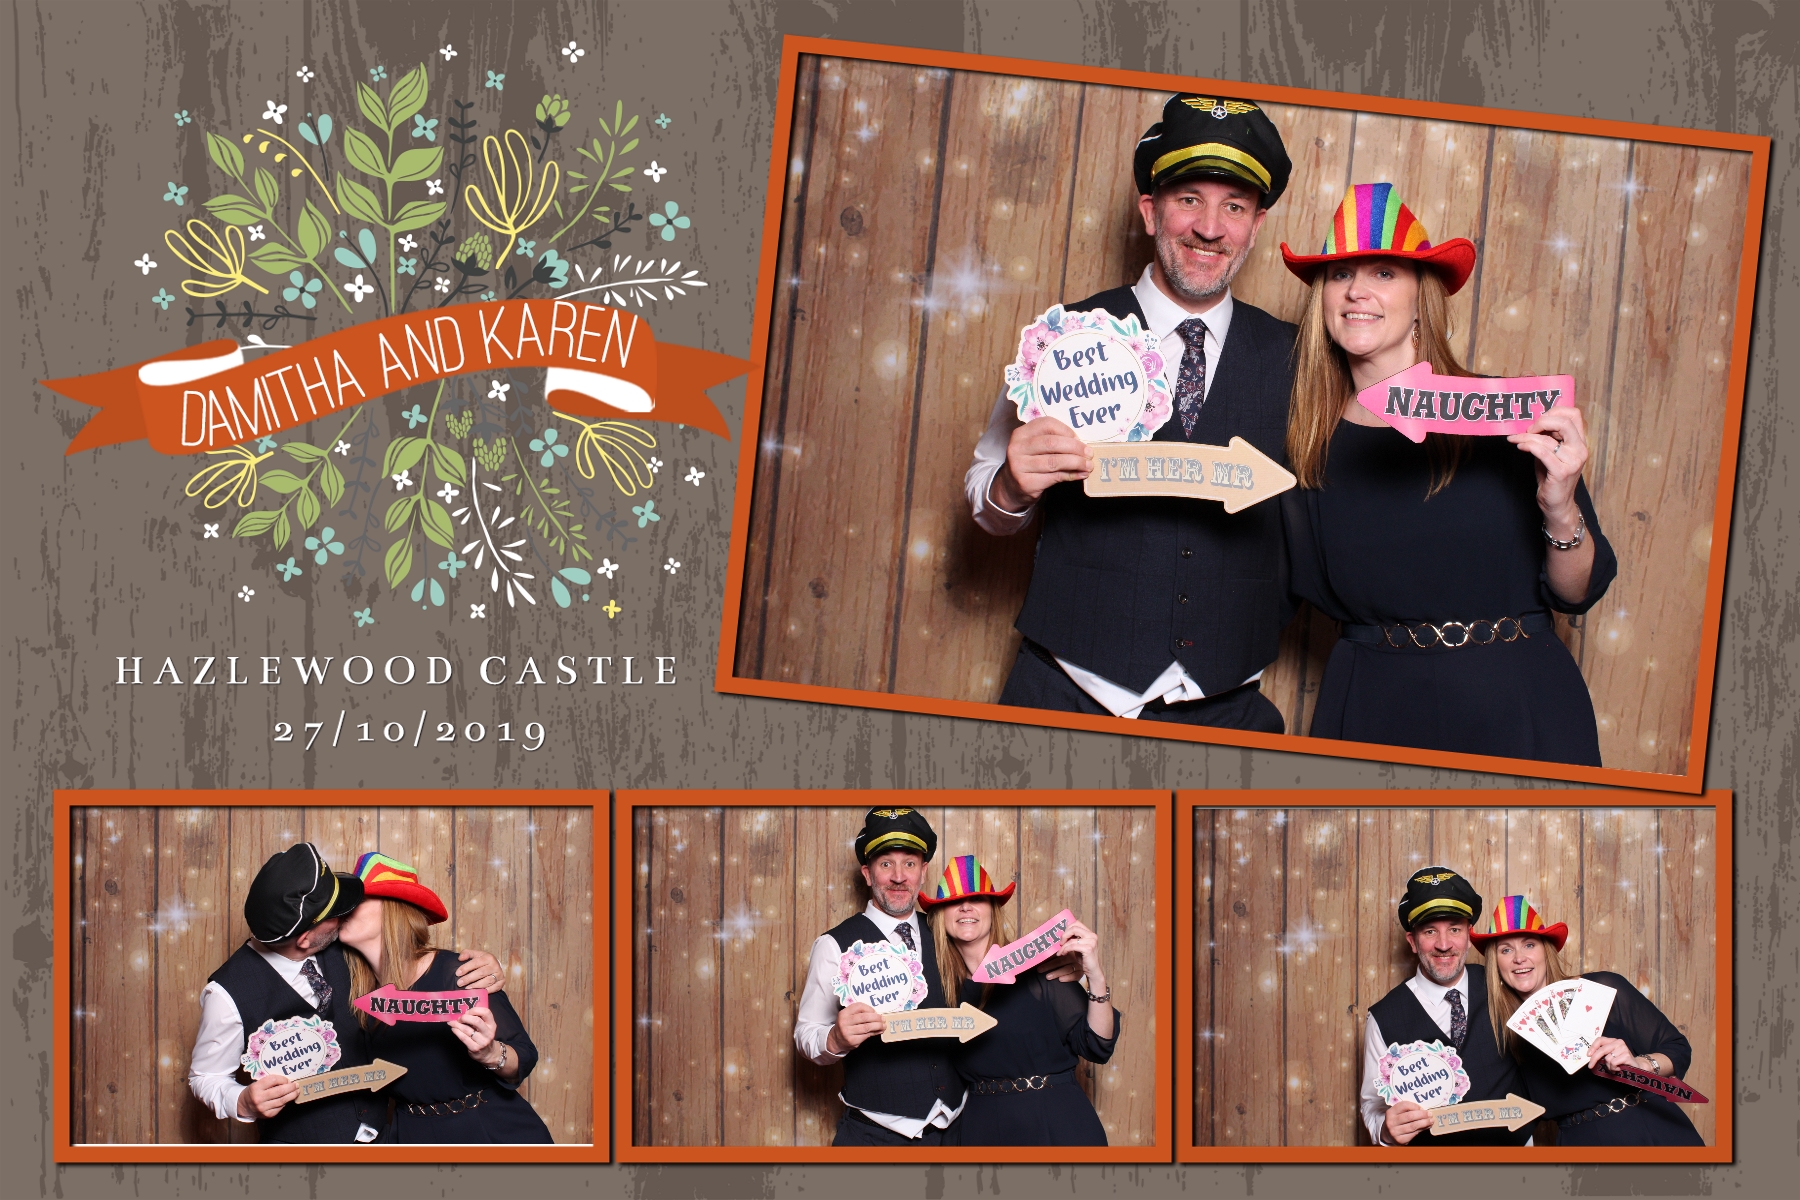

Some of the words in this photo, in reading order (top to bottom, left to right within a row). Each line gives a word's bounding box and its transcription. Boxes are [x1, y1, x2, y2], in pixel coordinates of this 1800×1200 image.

[1052, 341, 1110, 372] Best
[1040, 369, 1139, 406] Wedding
[1068, 403, 1121, 429] Ever
[1384, 385, 1562, 423] NAUGHTY
[1099, 456, 1140, 482] I'M
[1145, 456, 1203, 483] HER
[1210, 460, 1254, 490] MR
[984, 918, 1068, 981] NAUGHTY
[858, 957, 891, 976] Best
[852, 971, 909, 997] Wedding
[370, 996, 480, 1016] NAUGHTY
[869, 990, 900, 1007] Ever
[889, 1017, 912, 1034] I'M
[915, 1015, 948, 1031] HER
[951, 1015, 976, 1030] MR
[269, 1031, 304, 1051] Best
[263, 1041, 322, 1070] Wedding
[281, 1057, 313, 1076] Ever
[1397, 1056, 1430, 1076] Best
[303, 1080, 325, 1096] I'M
[328, 1073, 360, 1090] HER
[363, 1069, 386, 1083] MR
[1394, 1067, 1450, 1095] Wedding
[1413, 1085, 1443, 1104] Ever
[1436, 1112, 1460, 1128] I'M
[1462, 1107, 1495, 1123] HER
[1498, 1106, 1523, 1120] MR
